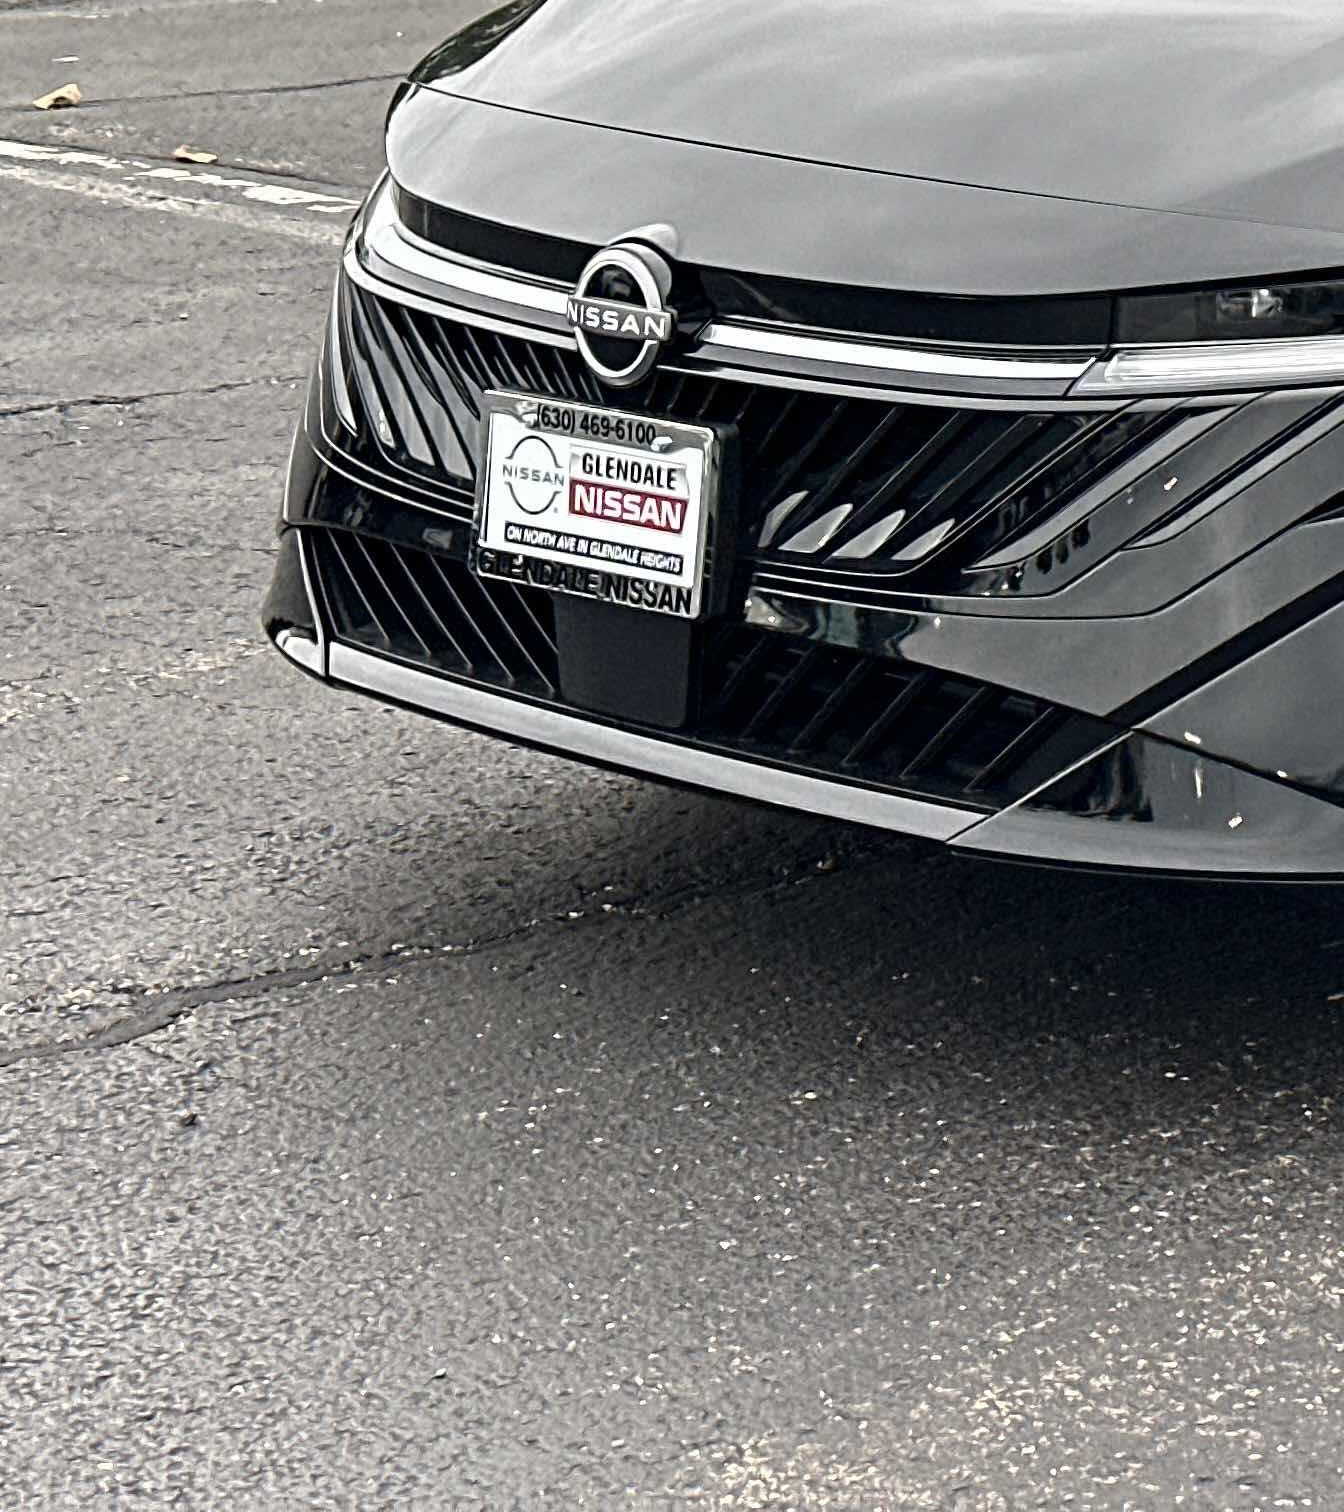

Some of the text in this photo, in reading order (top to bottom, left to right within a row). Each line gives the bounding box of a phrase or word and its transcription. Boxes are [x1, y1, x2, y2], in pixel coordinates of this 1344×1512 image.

[566, 299, 666, 338] NISSAN
[537, 403, 656, 446] (630) 469-6100
[502, 463, 565, 487] NISSAN
[581, 452, 678, 490] GLENDALE
[573, 484, 684, 530] NISSAN
[506, 524, 523, 541] ON
[556, 535, 577, 552] AVE
[577, 540, 589, 554] IN
[590, 541, 639, 564] GLENDALE
[640, 551, 681, 573] HEIGHTS
[606, 572, 692, 615] NISSAN
